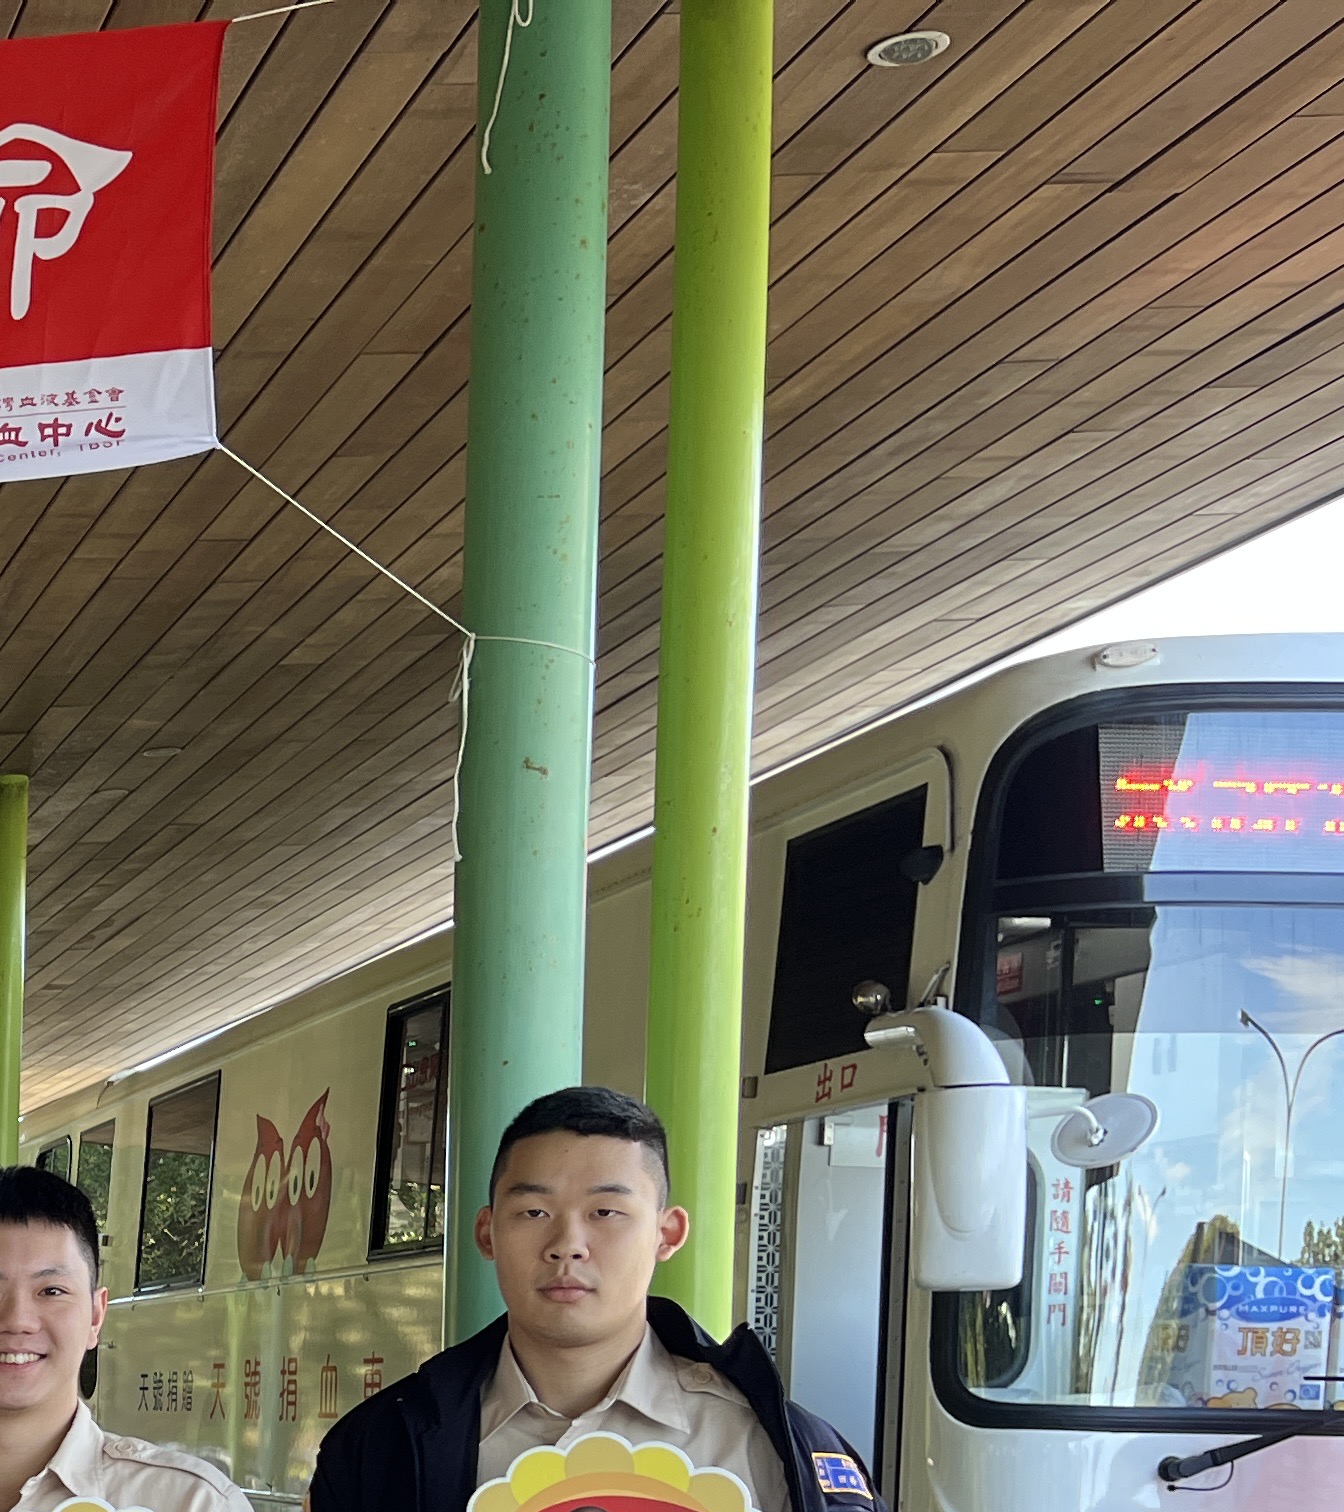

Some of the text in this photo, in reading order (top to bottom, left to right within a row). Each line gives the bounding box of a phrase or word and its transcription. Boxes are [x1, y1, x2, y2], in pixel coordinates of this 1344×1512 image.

[815, 1062, 858, 1103] 出口
[1238, 1303, 1307, 1314] MAXPURE
[1237, 1326, 1302, 1358] 頂好
